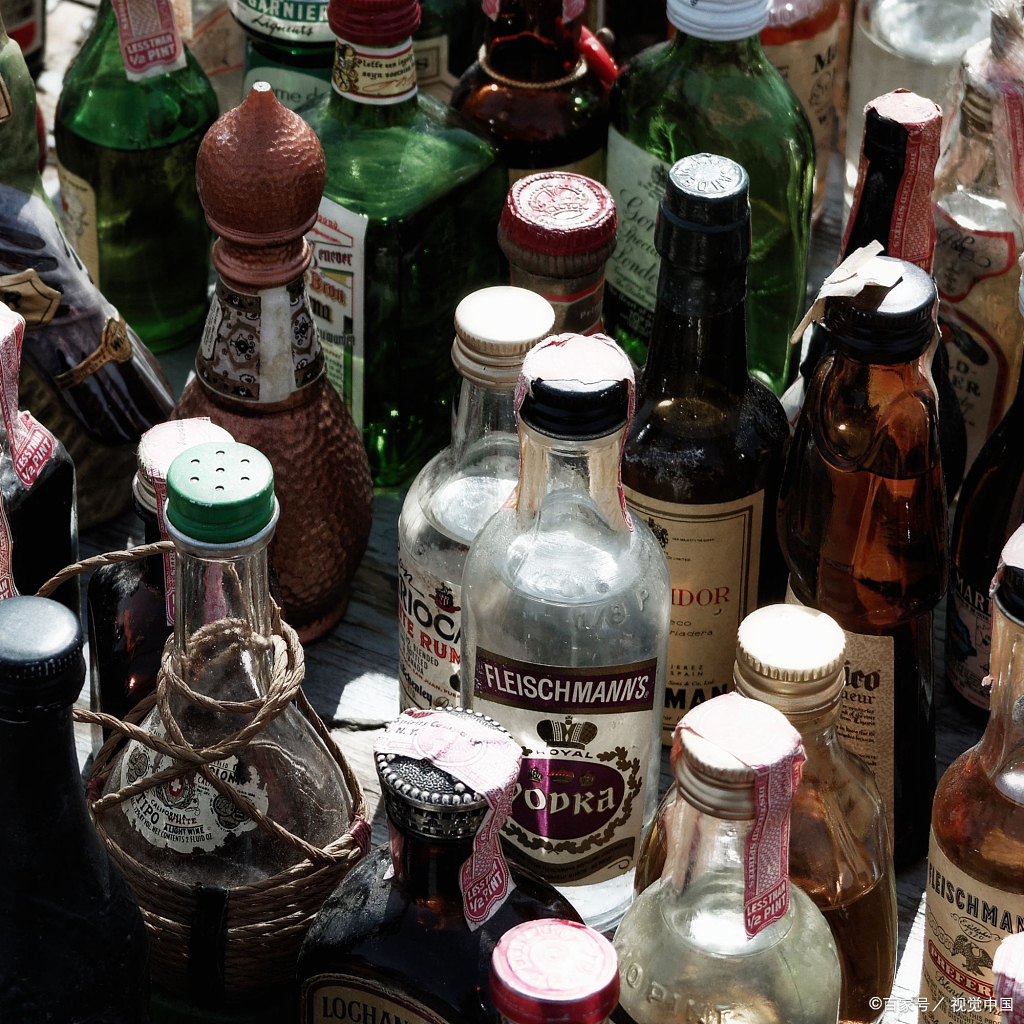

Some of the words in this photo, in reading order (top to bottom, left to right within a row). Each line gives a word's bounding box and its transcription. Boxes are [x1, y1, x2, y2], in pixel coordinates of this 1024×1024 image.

[147, 42, 176, 61] PINT
[32, 437, 52, 466] PINT
[398, 574, 461, 645] RIOC
[413, 644, 440, 668] BLENDED
[419, 629, 461, 665] RUM
[484, 662, 650, 704] FLEISCHMANN'S
[135, 793, 161, 826] TIPO
[150, 798, 187, 820] CALIFORNIA
[167, 814, 198, 825] WHITE
[187, 826, 205, 835] WINE
[482, 872, 503, 900] PINT
[746, 897, 769, 916] LESS
[767, 882, 786, 902] THAN
[763, 893, 786, 920] PINT
[929, 948, 995, 998] PREFER
